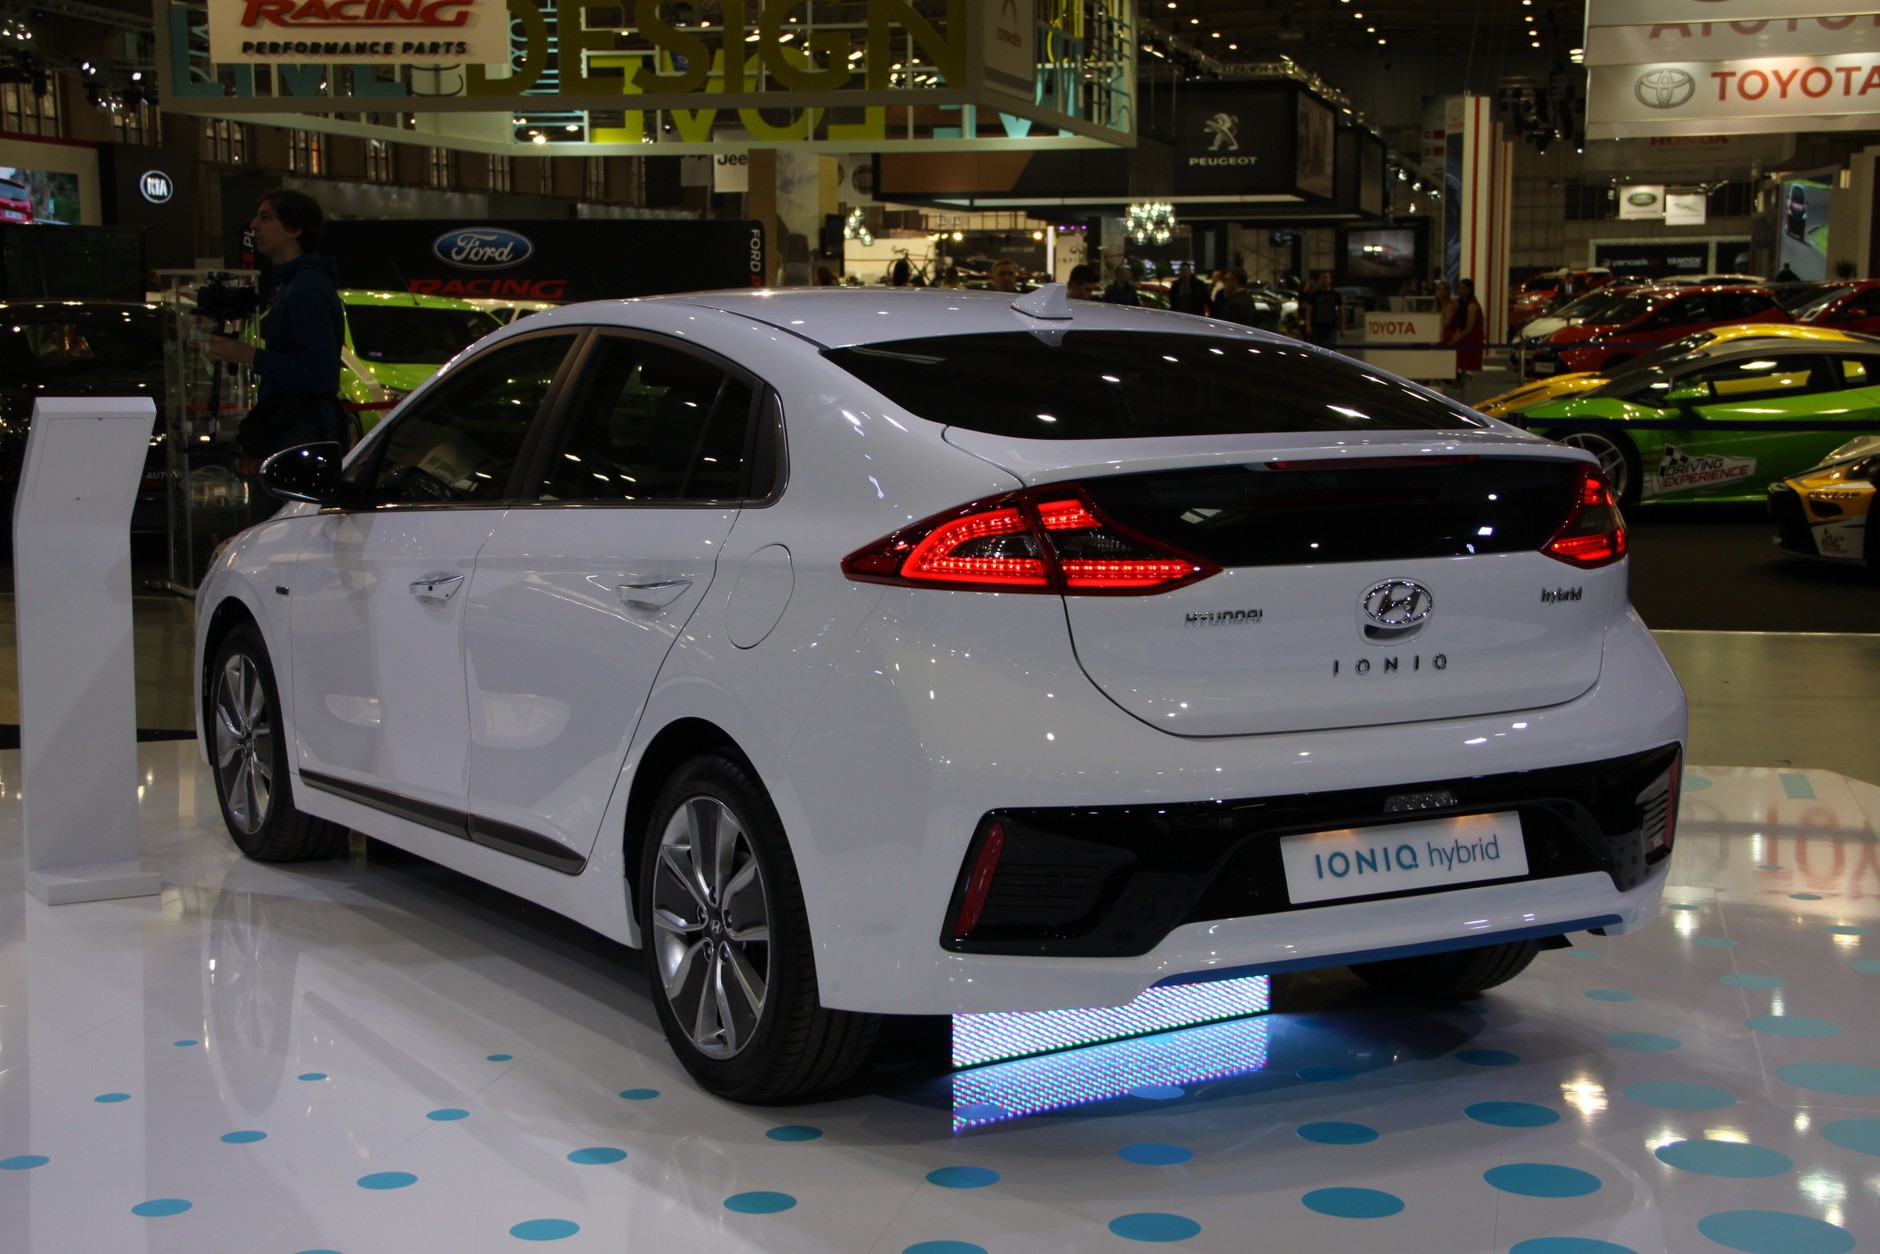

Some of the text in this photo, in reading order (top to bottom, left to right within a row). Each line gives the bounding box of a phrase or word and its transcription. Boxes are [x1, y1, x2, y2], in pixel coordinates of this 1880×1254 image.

[241, 0, 473, 26] RACING
[242, 41, 467, 55] PERFORMANCE PARTS
[717, 154, 748, 166] Jee
[1188, 156, 1258, 166] PEUGEOT
[147, 177, 169, 197] KIA
[452, 231, 514, 264] Ford
[408, 278, 568, 299] RACING
[1368, 321, 1416, 335] TOYOTA
[1663, 464, 1749, 488] EXPERIENCE
[1664, 458, 1724, 477] DRIVING
[1541, 586, 1583, 606] hybrid
[1185, 608, 1263, 627] HYUNDAI
[1333, 653, 1448, 677] IONIQ
[1315, 834, 1501, 880] IONIQ hybrid
